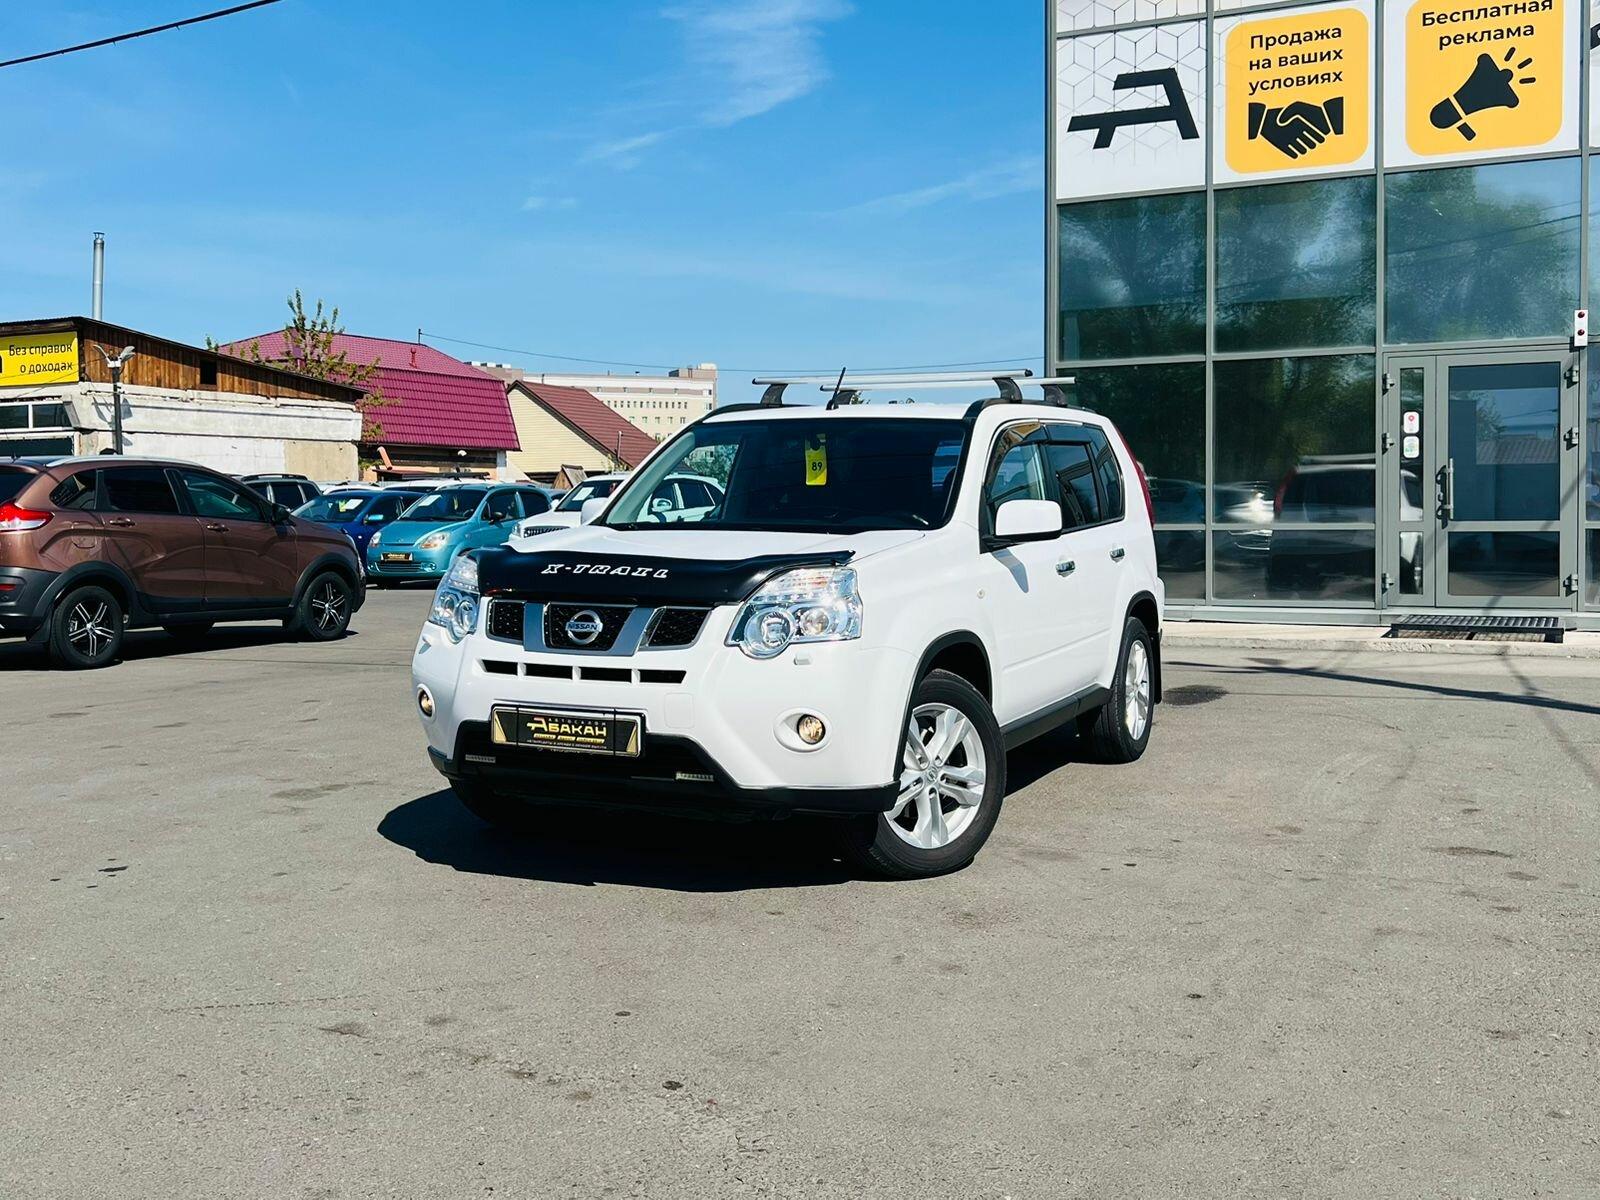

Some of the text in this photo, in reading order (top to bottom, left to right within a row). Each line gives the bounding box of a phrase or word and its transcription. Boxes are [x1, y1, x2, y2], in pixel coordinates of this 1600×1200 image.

[1422, 0, 1553, 27] Бесплатная
[1250, 27, 1342, 51] Продажа
[1438, 24, 1535, 50] реклама
[1249, 49, 1343, 71] на ваших
[1248, 71, 1343, 96] условиях
[9, 344, 73, 356] Без справок
[20, 361, 73, 375] о доходах
[811, 461, 823, 471] 89
[541, 564, 669, 578] X-TRAIL
[567, 622, 598, 632] NISSAN
